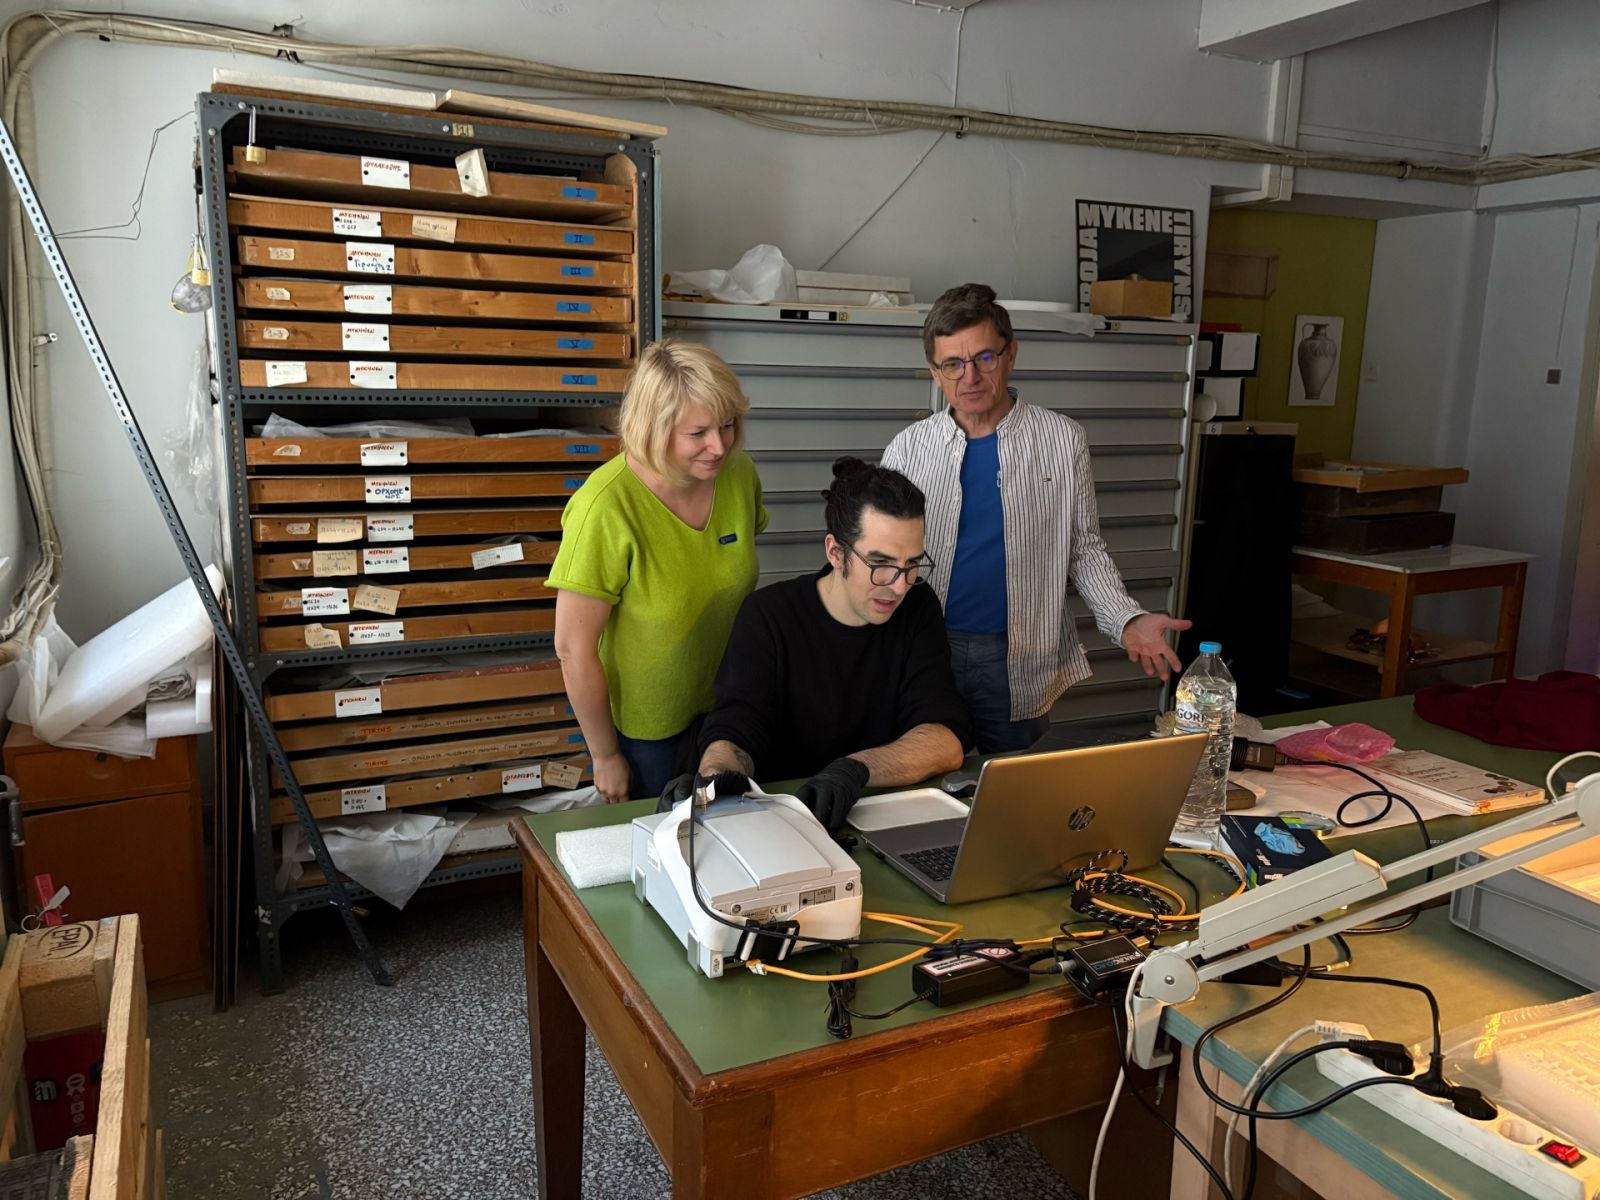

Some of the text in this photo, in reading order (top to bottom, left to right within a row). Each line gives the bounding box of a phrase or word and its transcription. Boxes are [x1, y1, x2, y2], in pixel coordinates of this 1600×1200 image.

[576, 188, 582, 197] I
[1079, 203, 1173, 233] MYKENE
[574, 234, 584, 243] II
[1173, 211, 1192, 318] TIRYNS
[570, 267, 581, 275] III
[568, 303, 579, 311] IV
[568, 340, 580, 349] V
[573, 375, 584, 384] VI
[1211, 424, 1216, 433] 6
